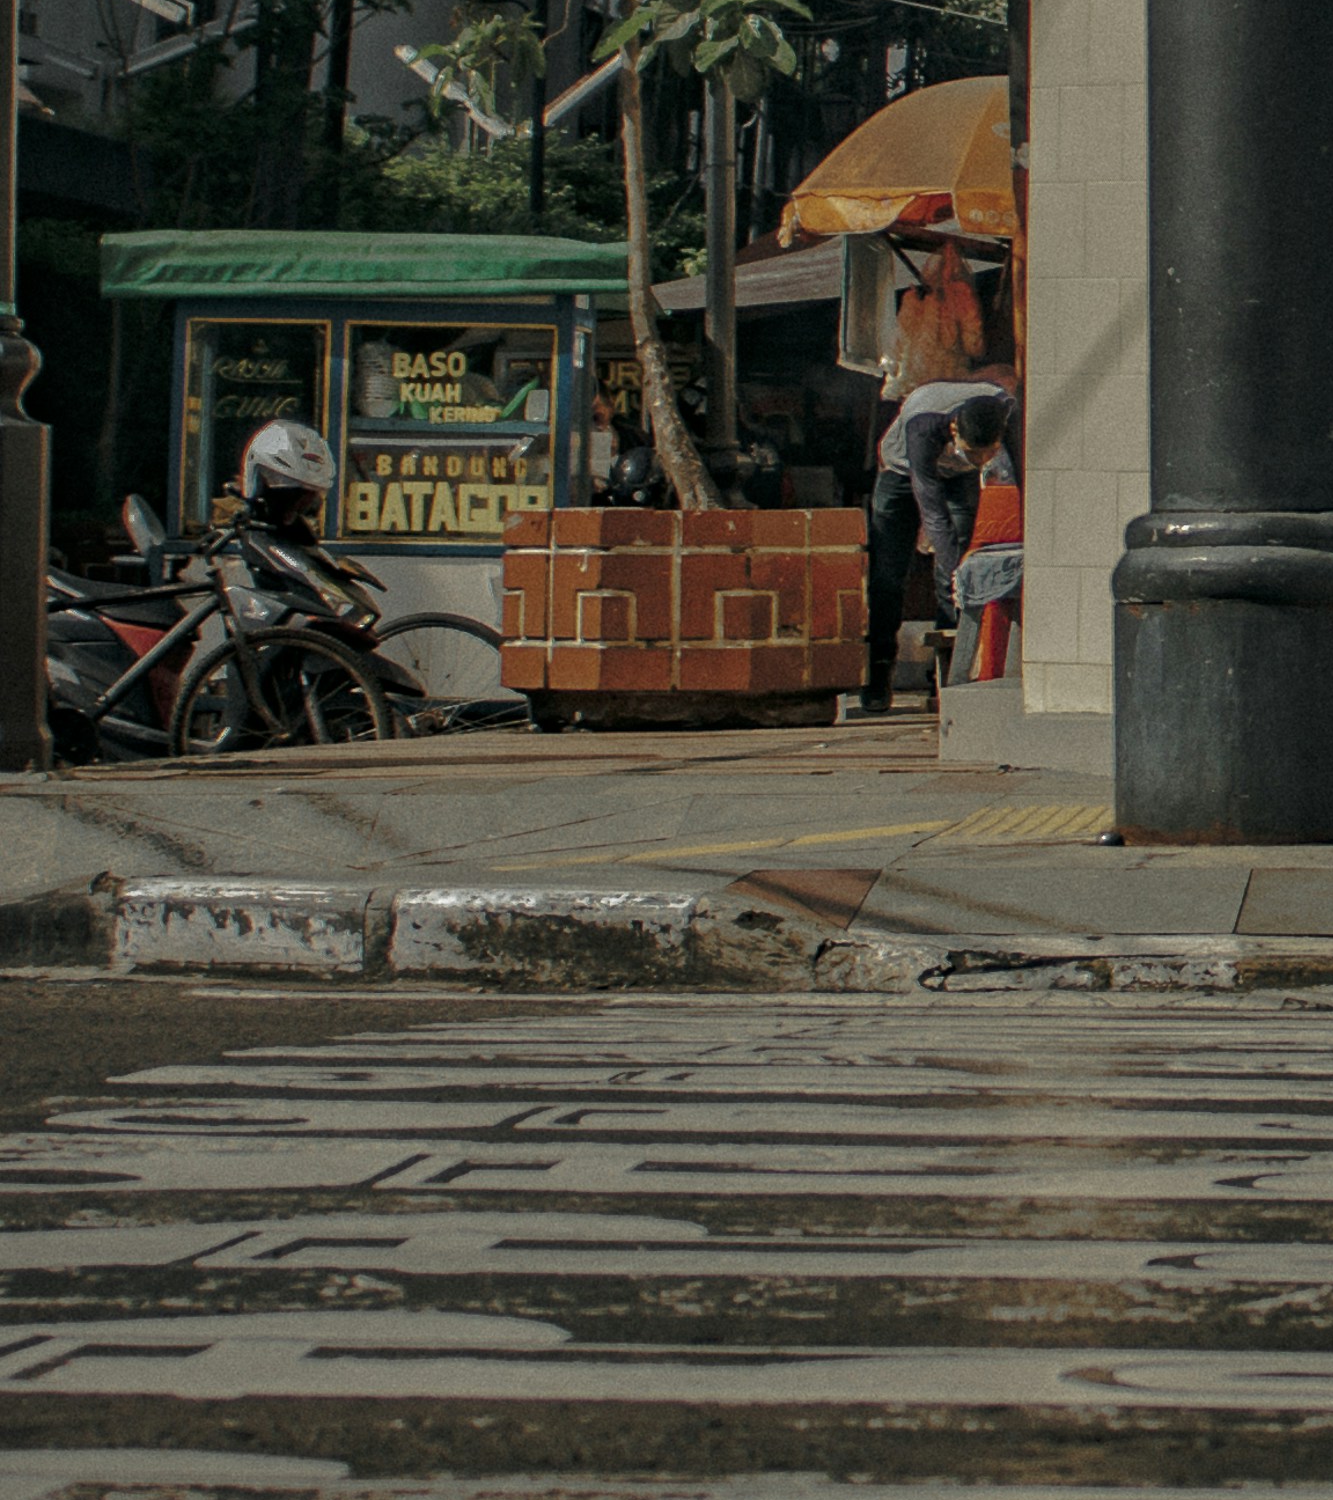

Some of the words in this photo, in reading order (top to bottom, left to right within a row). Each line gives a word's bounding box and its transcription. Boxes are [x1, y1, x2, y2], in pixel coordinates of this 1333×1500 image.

[391, 351, 467, 379] BASO
[400, 383, 462, 403] KUAH
[375, 453, 528, 478] BANDUNG
